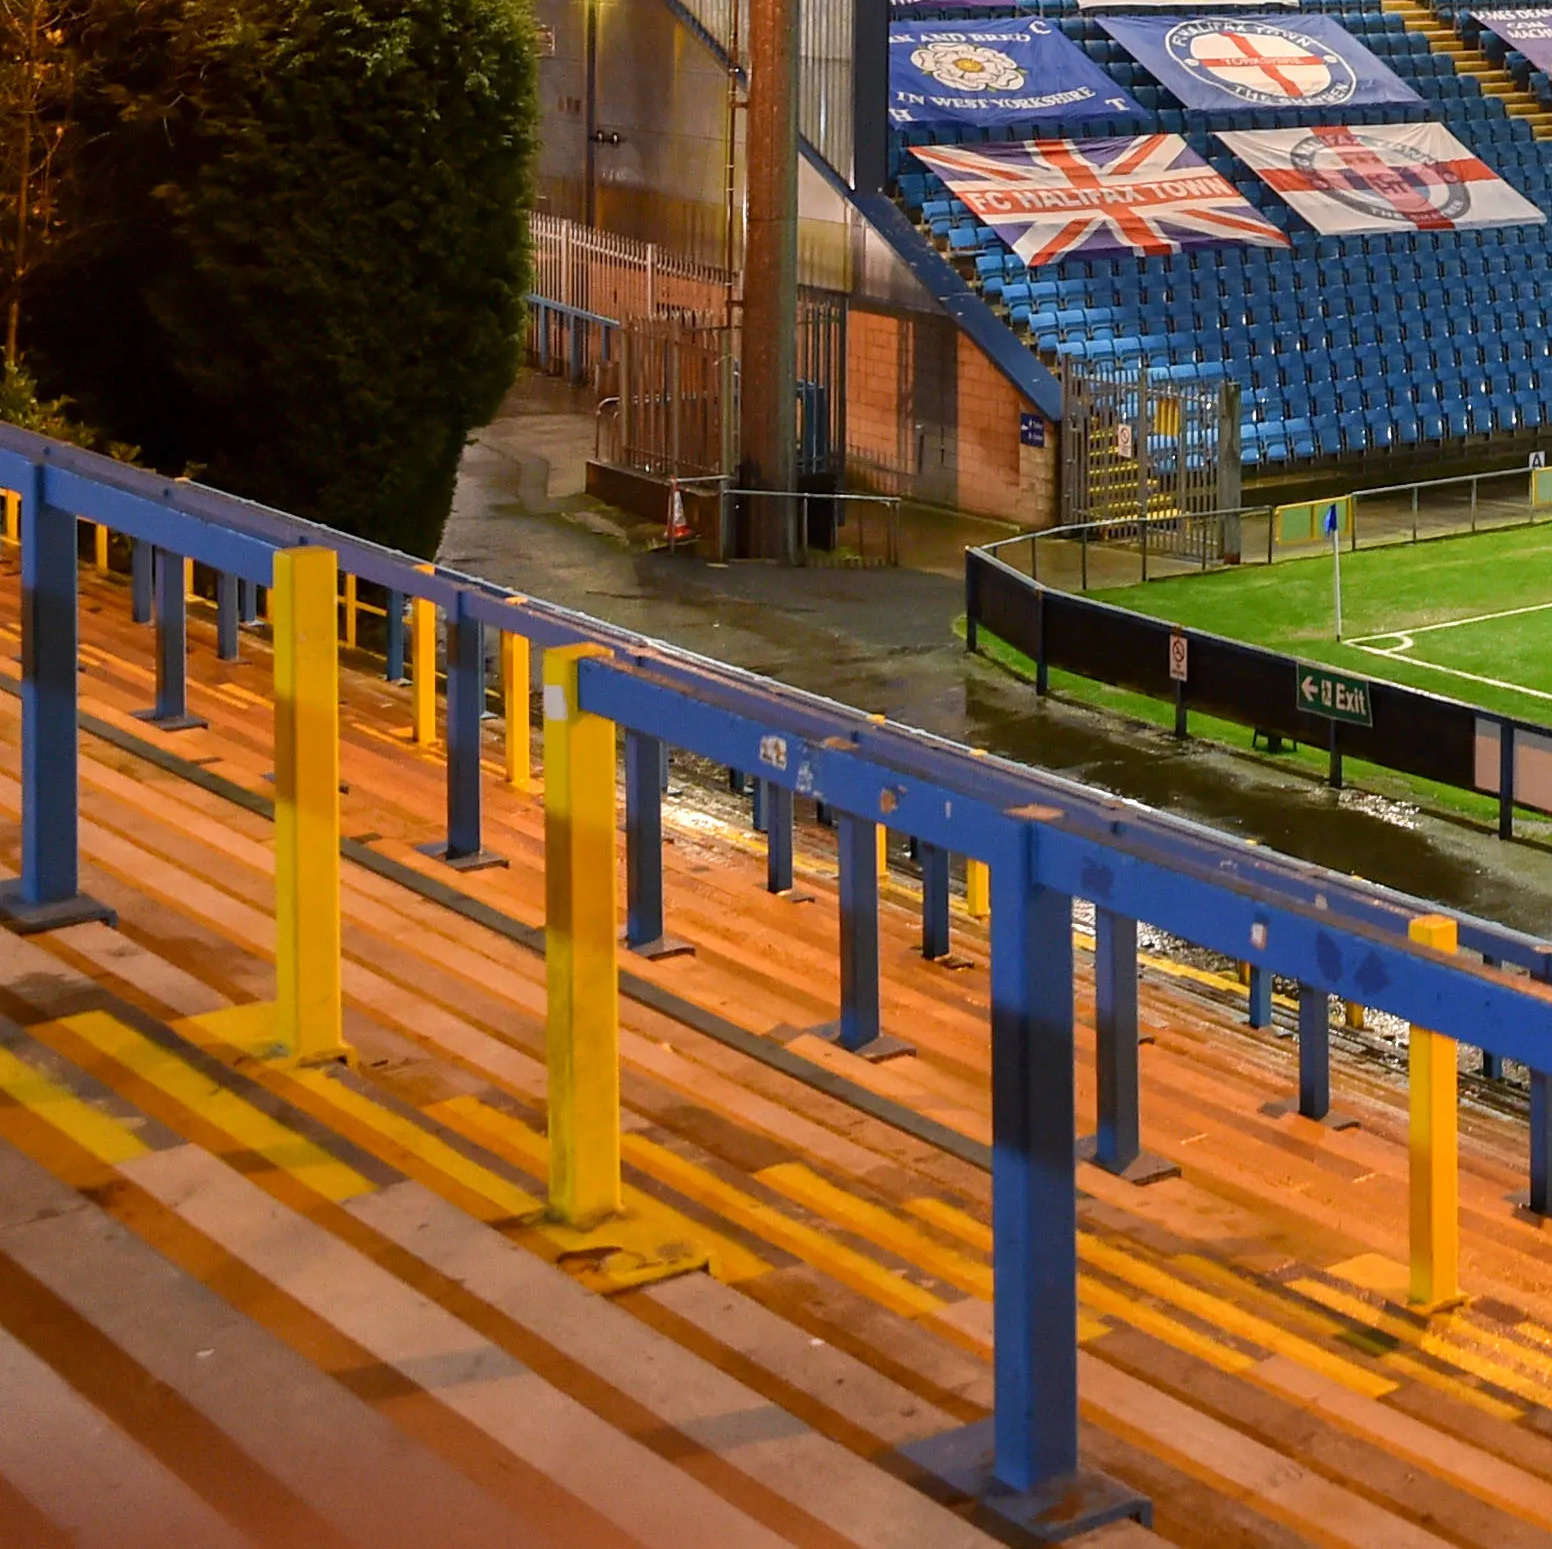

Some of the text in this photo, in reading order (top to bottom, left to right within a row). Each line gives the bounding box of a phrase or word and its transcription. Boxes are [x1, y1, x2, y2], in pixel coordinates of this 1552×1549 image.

[1029, 20, 1053, 35] C
[920, 32, 967, 43] AND
[968, 32, 1031, 43] BRED
[896, 85, 1097, 110] IN WEST YORKSHIRE
[1105, 97, 1131, 112] T
[964, 176, 1234, 211] FC HALIFAX TOWN
[1532, 453, 1543, 468] A
[1336, 682, 1367, 715] Exit
